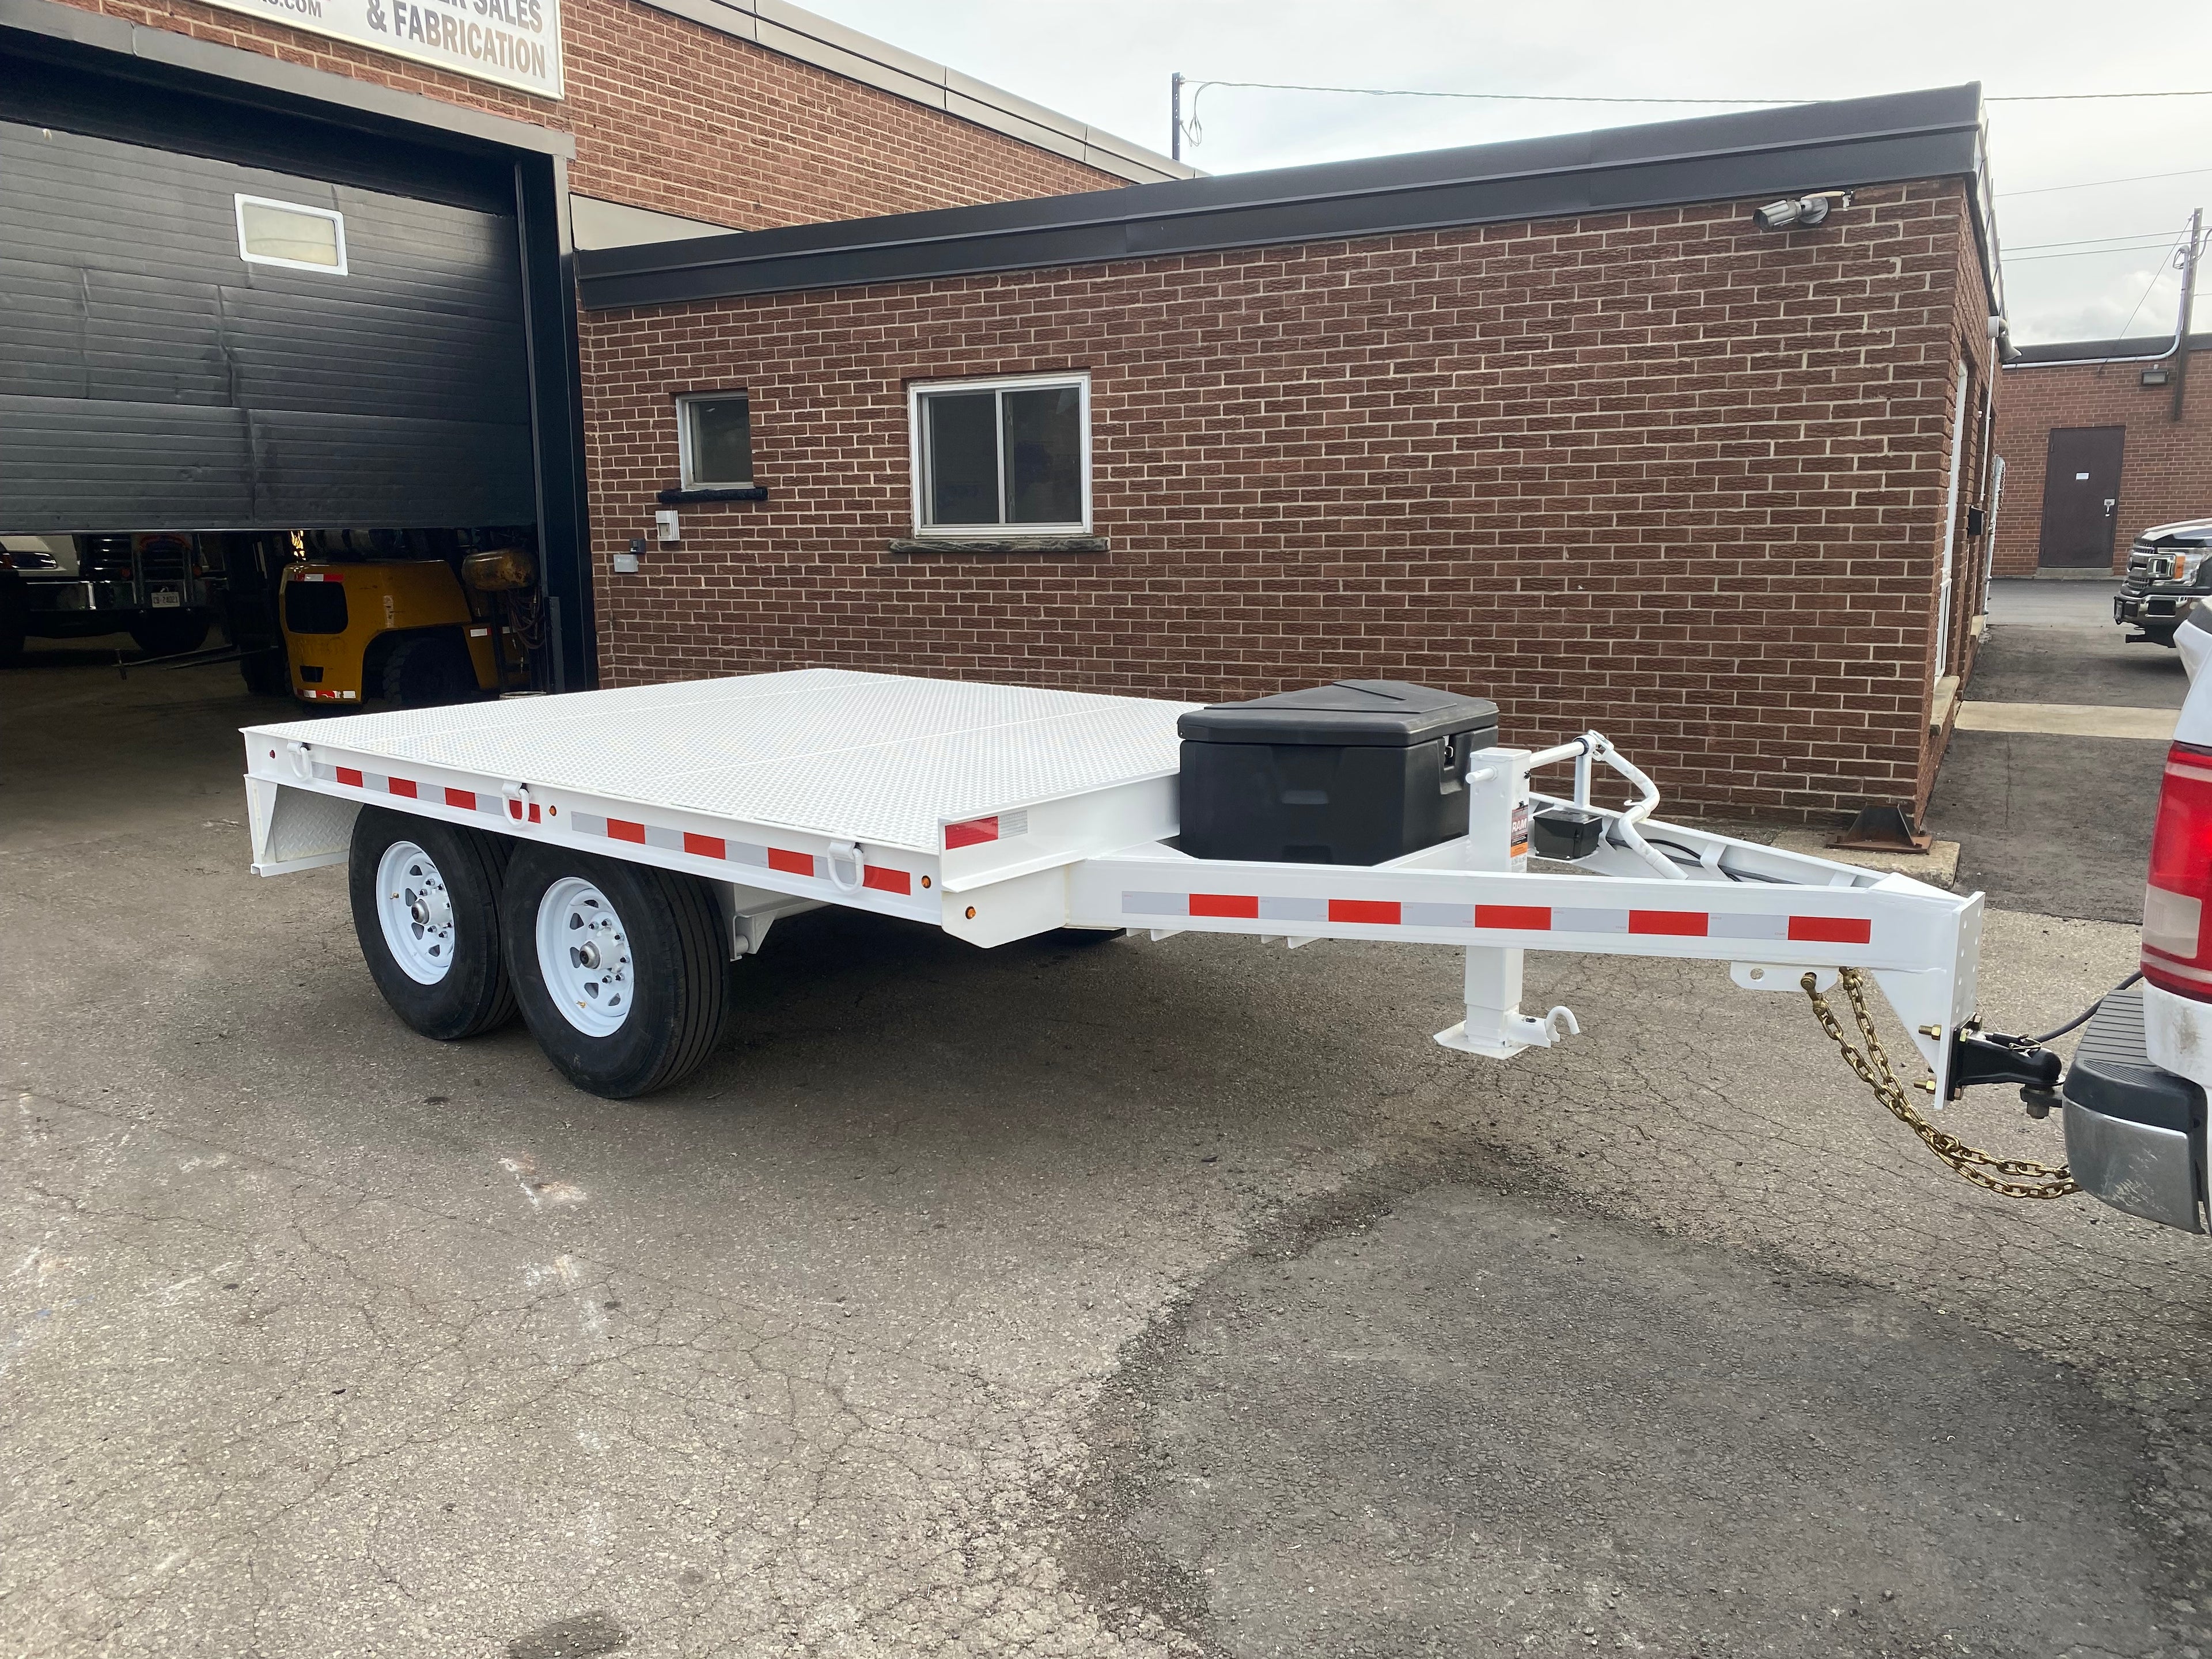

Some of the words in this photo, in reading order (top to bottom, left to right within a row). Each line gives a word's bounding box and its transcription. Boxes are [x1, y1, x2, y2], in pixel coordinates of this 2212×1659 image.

[367, 0, 387, 33] &
[393, 0, 546, 78] FABRICATION
[1512, 818, 1528, 833] RAM
